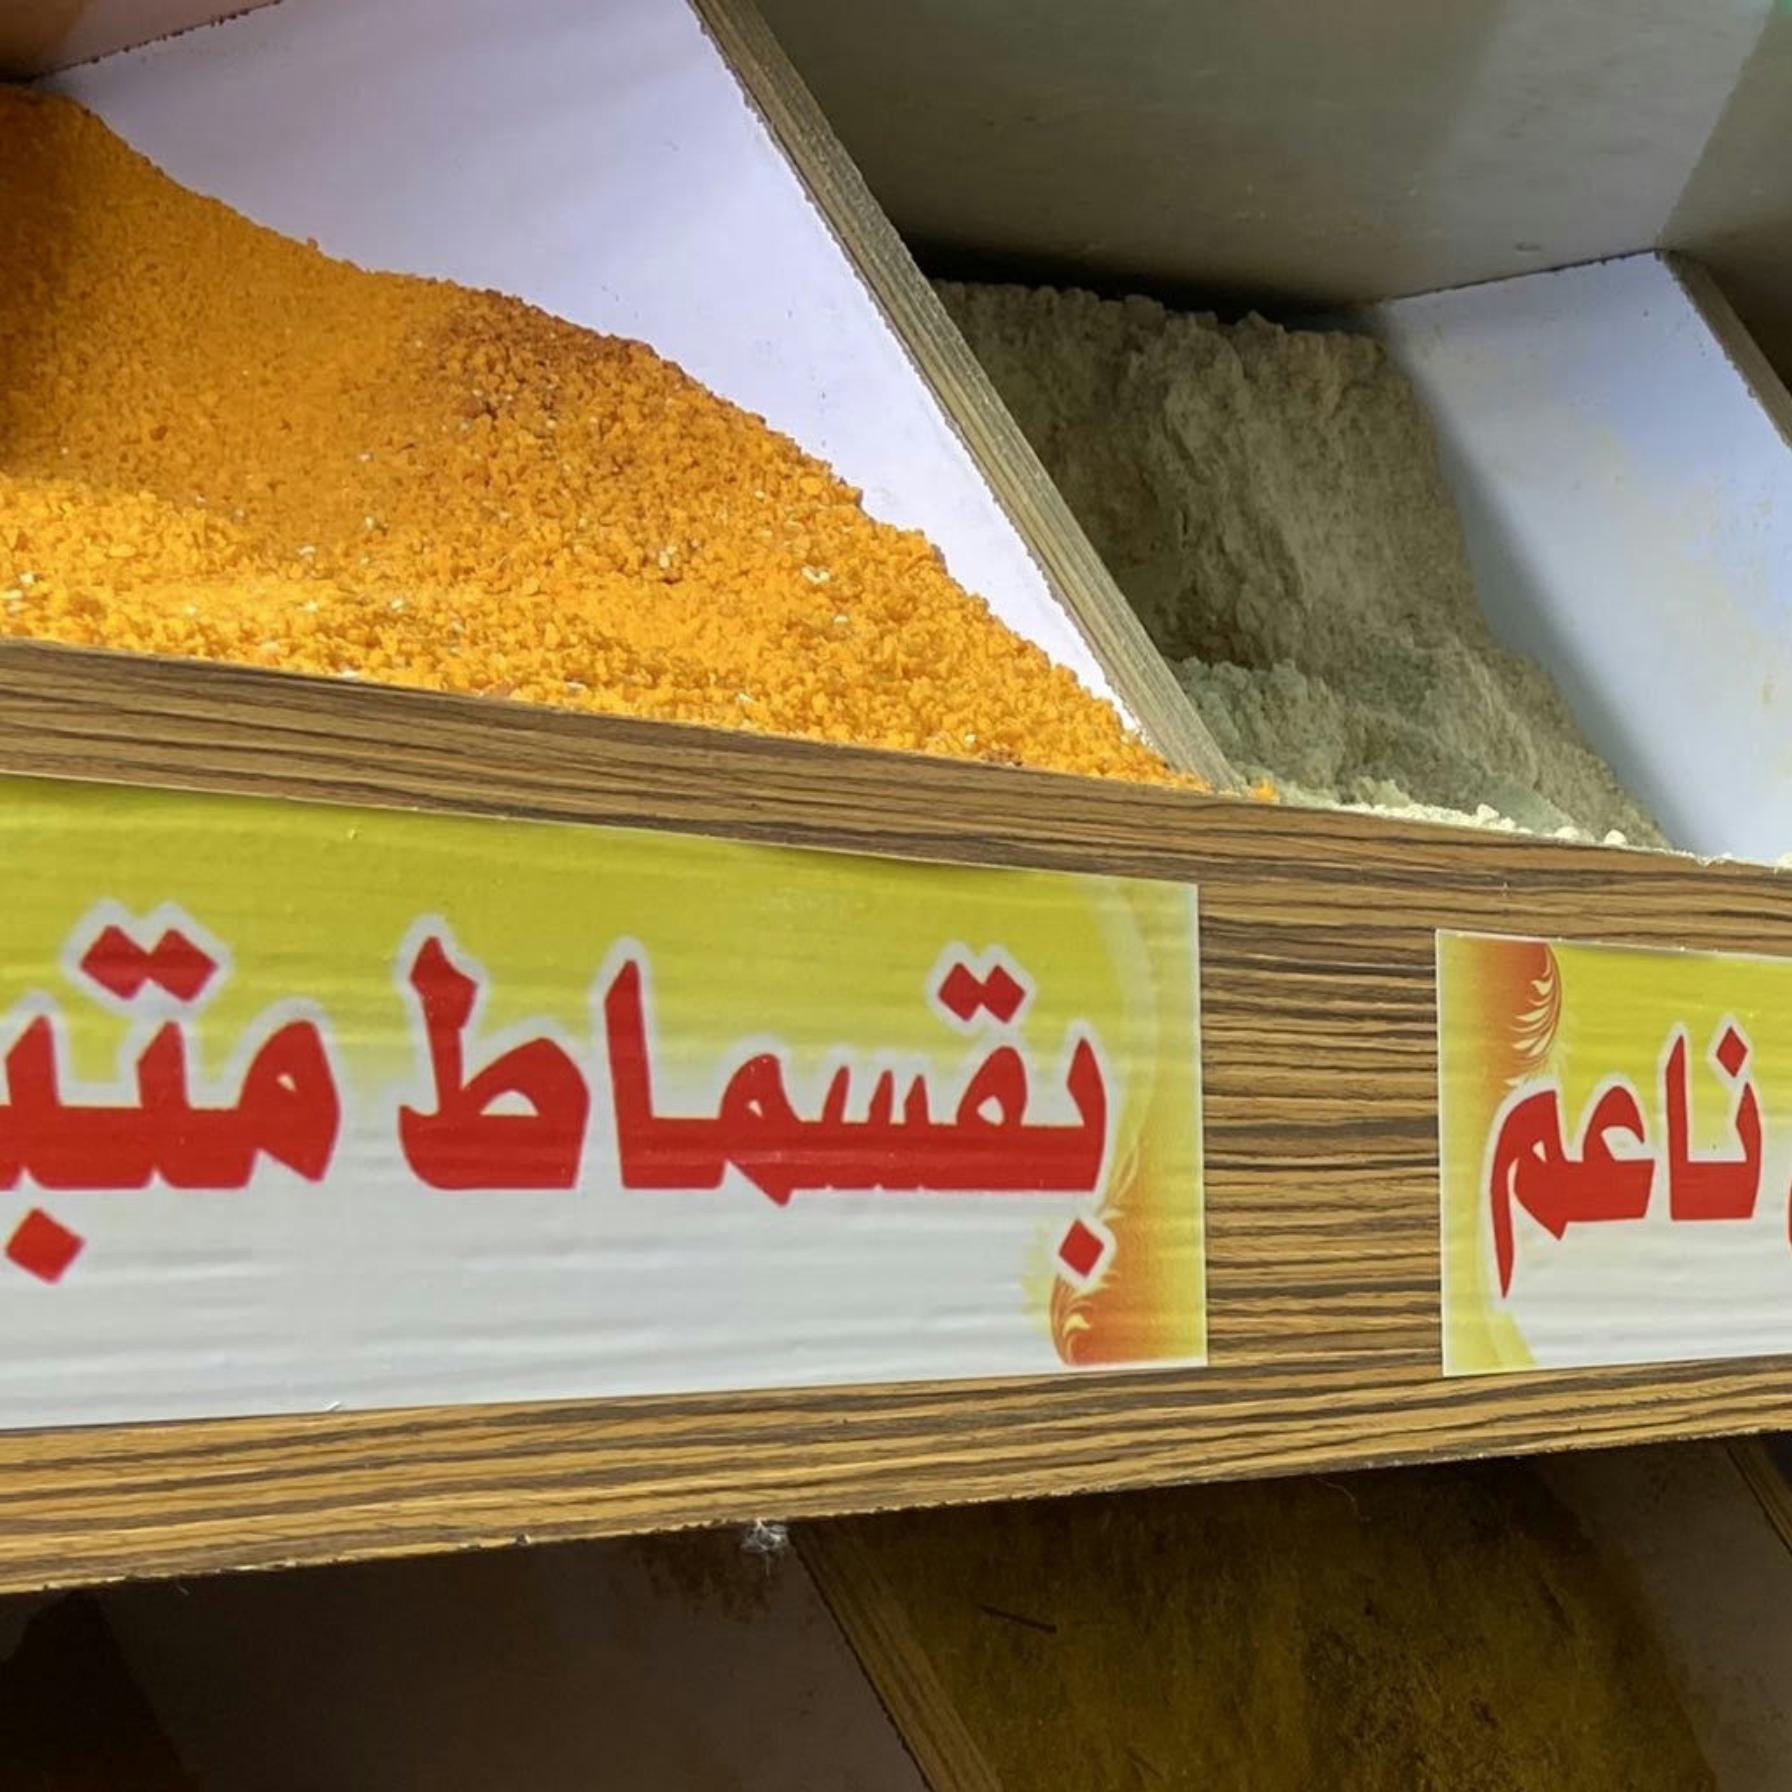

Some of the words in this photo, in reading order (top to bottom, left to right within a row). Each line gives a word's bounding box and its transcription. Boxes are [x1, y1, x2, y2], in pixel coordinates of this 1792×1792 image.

[0, 927, 339, 1281] متب
[399, 938, 1106, 1275] بقسماط
[1490, 1031, 1762, 1296] ناعم
